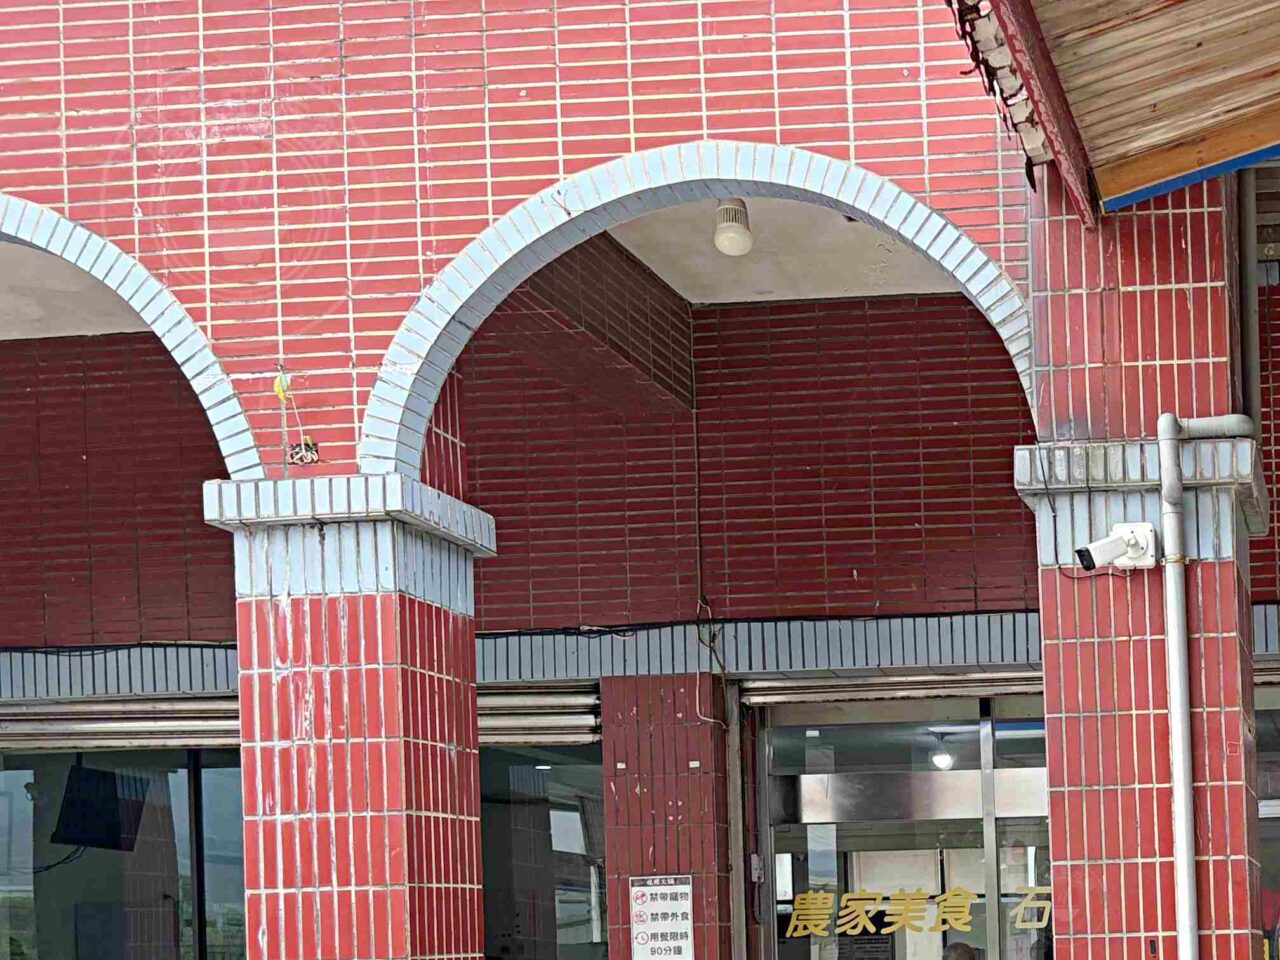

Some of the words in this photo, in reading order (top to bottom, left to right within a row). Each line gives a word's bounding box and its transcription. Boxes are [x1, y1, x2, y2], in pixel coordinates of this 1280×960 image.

[650, 892, 689, 902] 禁帶寵物
[650, 911, 689, 922] 禁帶外食
[785, 886, 978, 938] 農家美食
[1009, 886, 1051, 929] 石
[650, 931, 689, 942] 用餐限時
